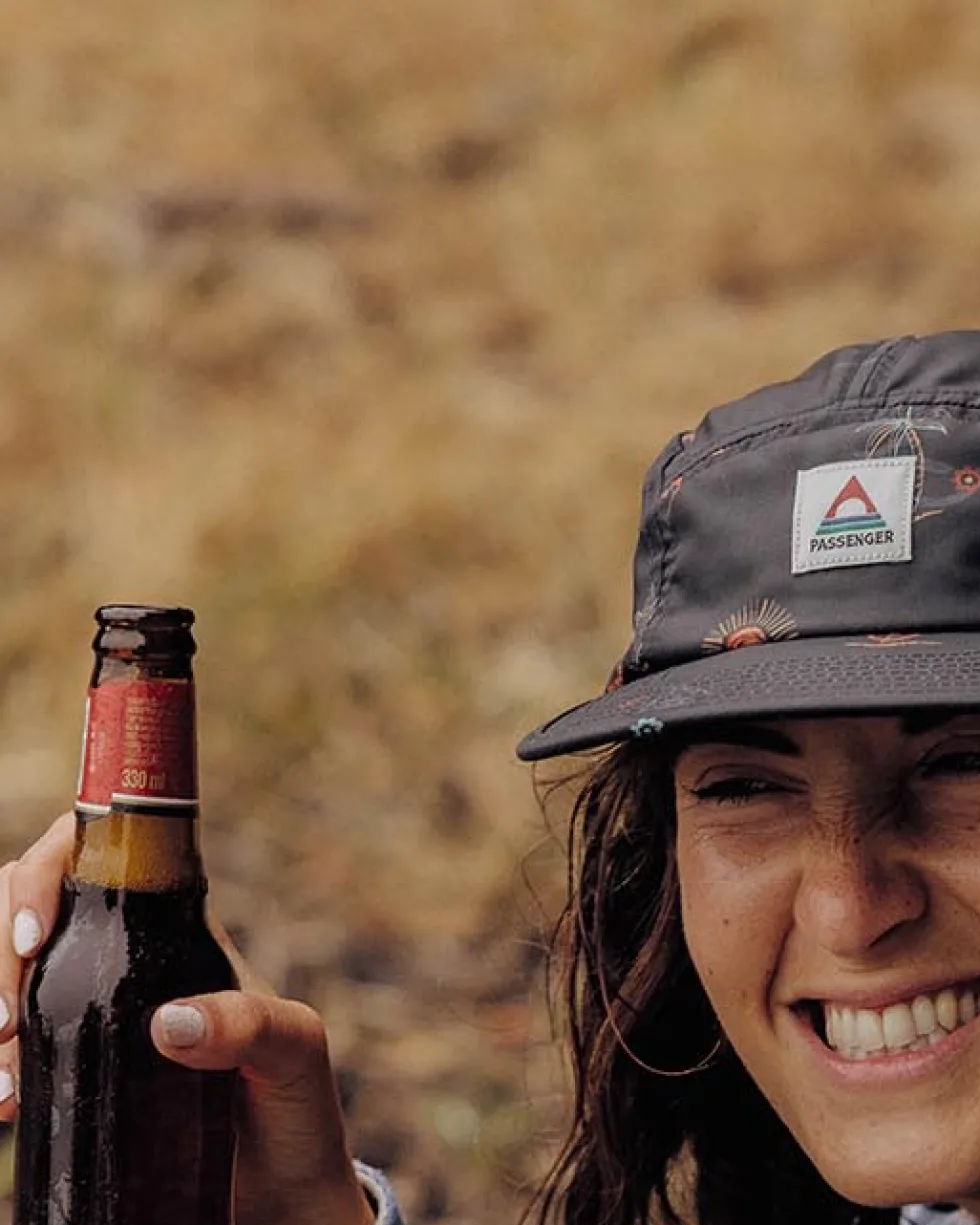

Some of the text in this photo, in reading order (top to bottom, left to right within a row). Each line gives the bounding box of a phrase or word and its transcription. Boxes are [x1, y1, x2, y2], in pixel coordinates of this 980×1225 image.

[810, 530, 895, 552] PASSENGER
[121, 768, 165, 790] 330 ml
